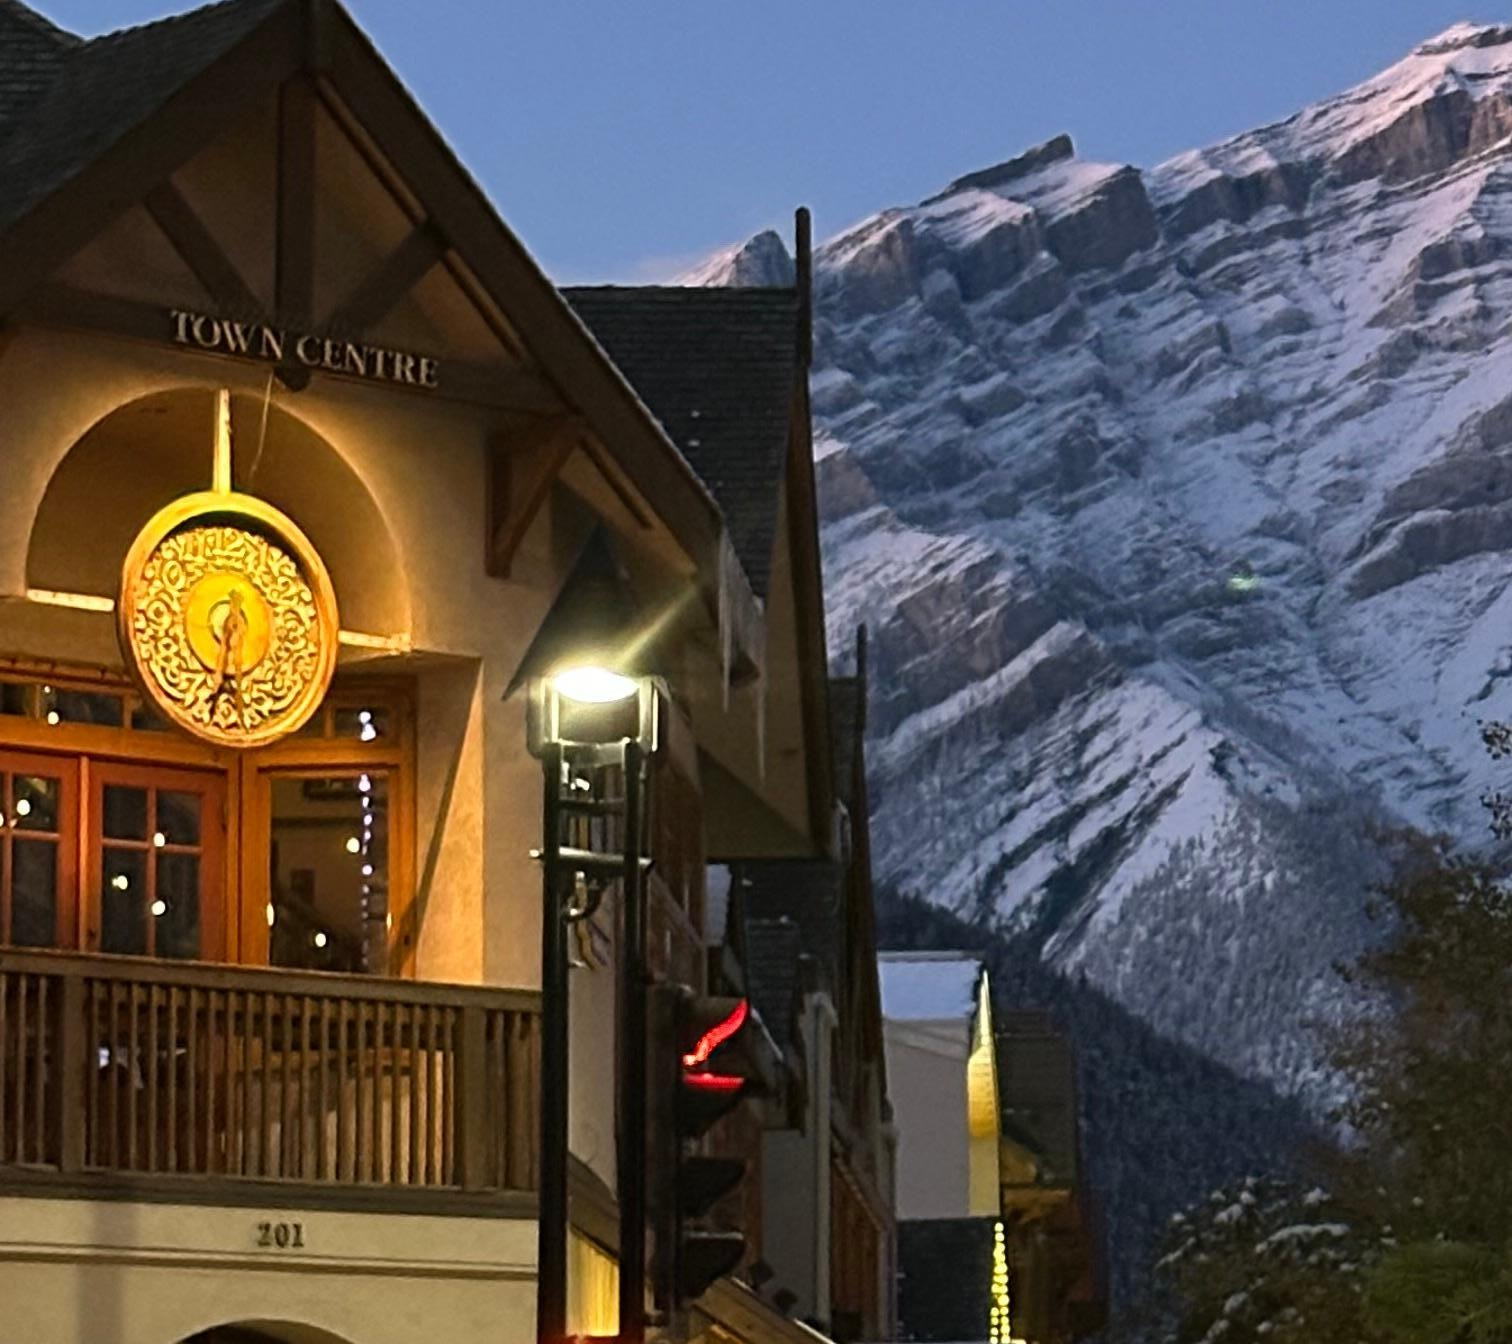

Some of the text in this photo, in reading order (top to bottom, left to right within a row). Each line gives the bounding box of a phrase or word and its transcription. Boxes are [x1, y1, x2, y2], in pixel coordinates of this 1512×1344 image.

[171, 310, 439, 387] TOWN CENTRE
[257, 1222, 305, 1249] 201
